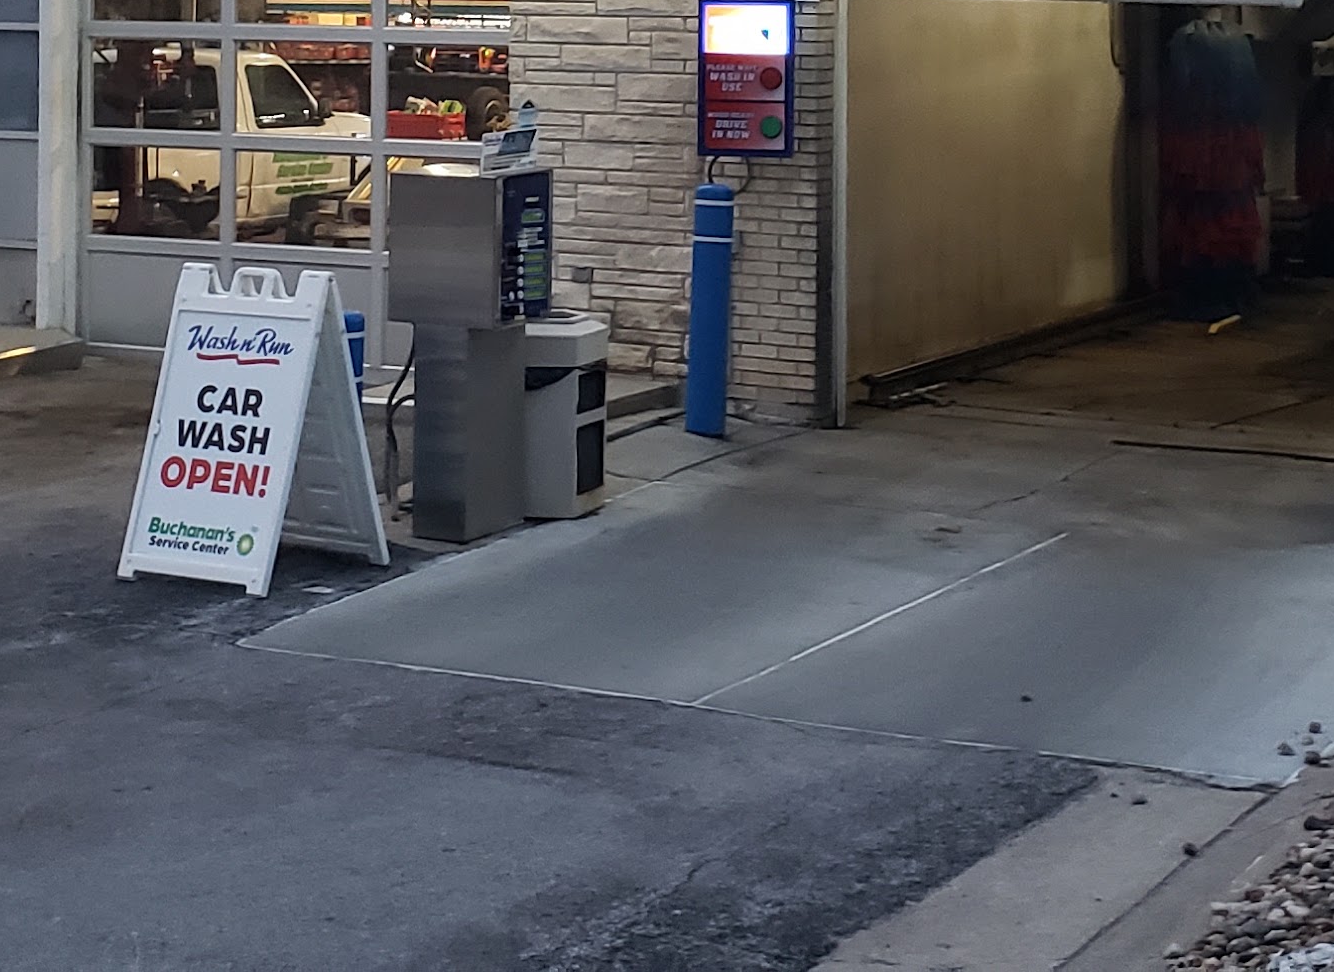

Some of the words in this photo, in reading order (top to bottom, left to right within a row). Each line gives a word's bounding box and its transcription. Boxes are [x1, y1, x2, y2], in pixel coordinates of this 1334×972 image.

[187, 325, 240, 352] Wash
[254, 328, 294, 356] Run
[197, 385, 263, 418] CAR
[177, 419, 271, 455] WASH
[160, 456, 271, 498] OPEN!
[148, 516, 236, 542] Buchanan's
[149, 535, 189, 550] Service
[192, 541, 229, 555] Center
